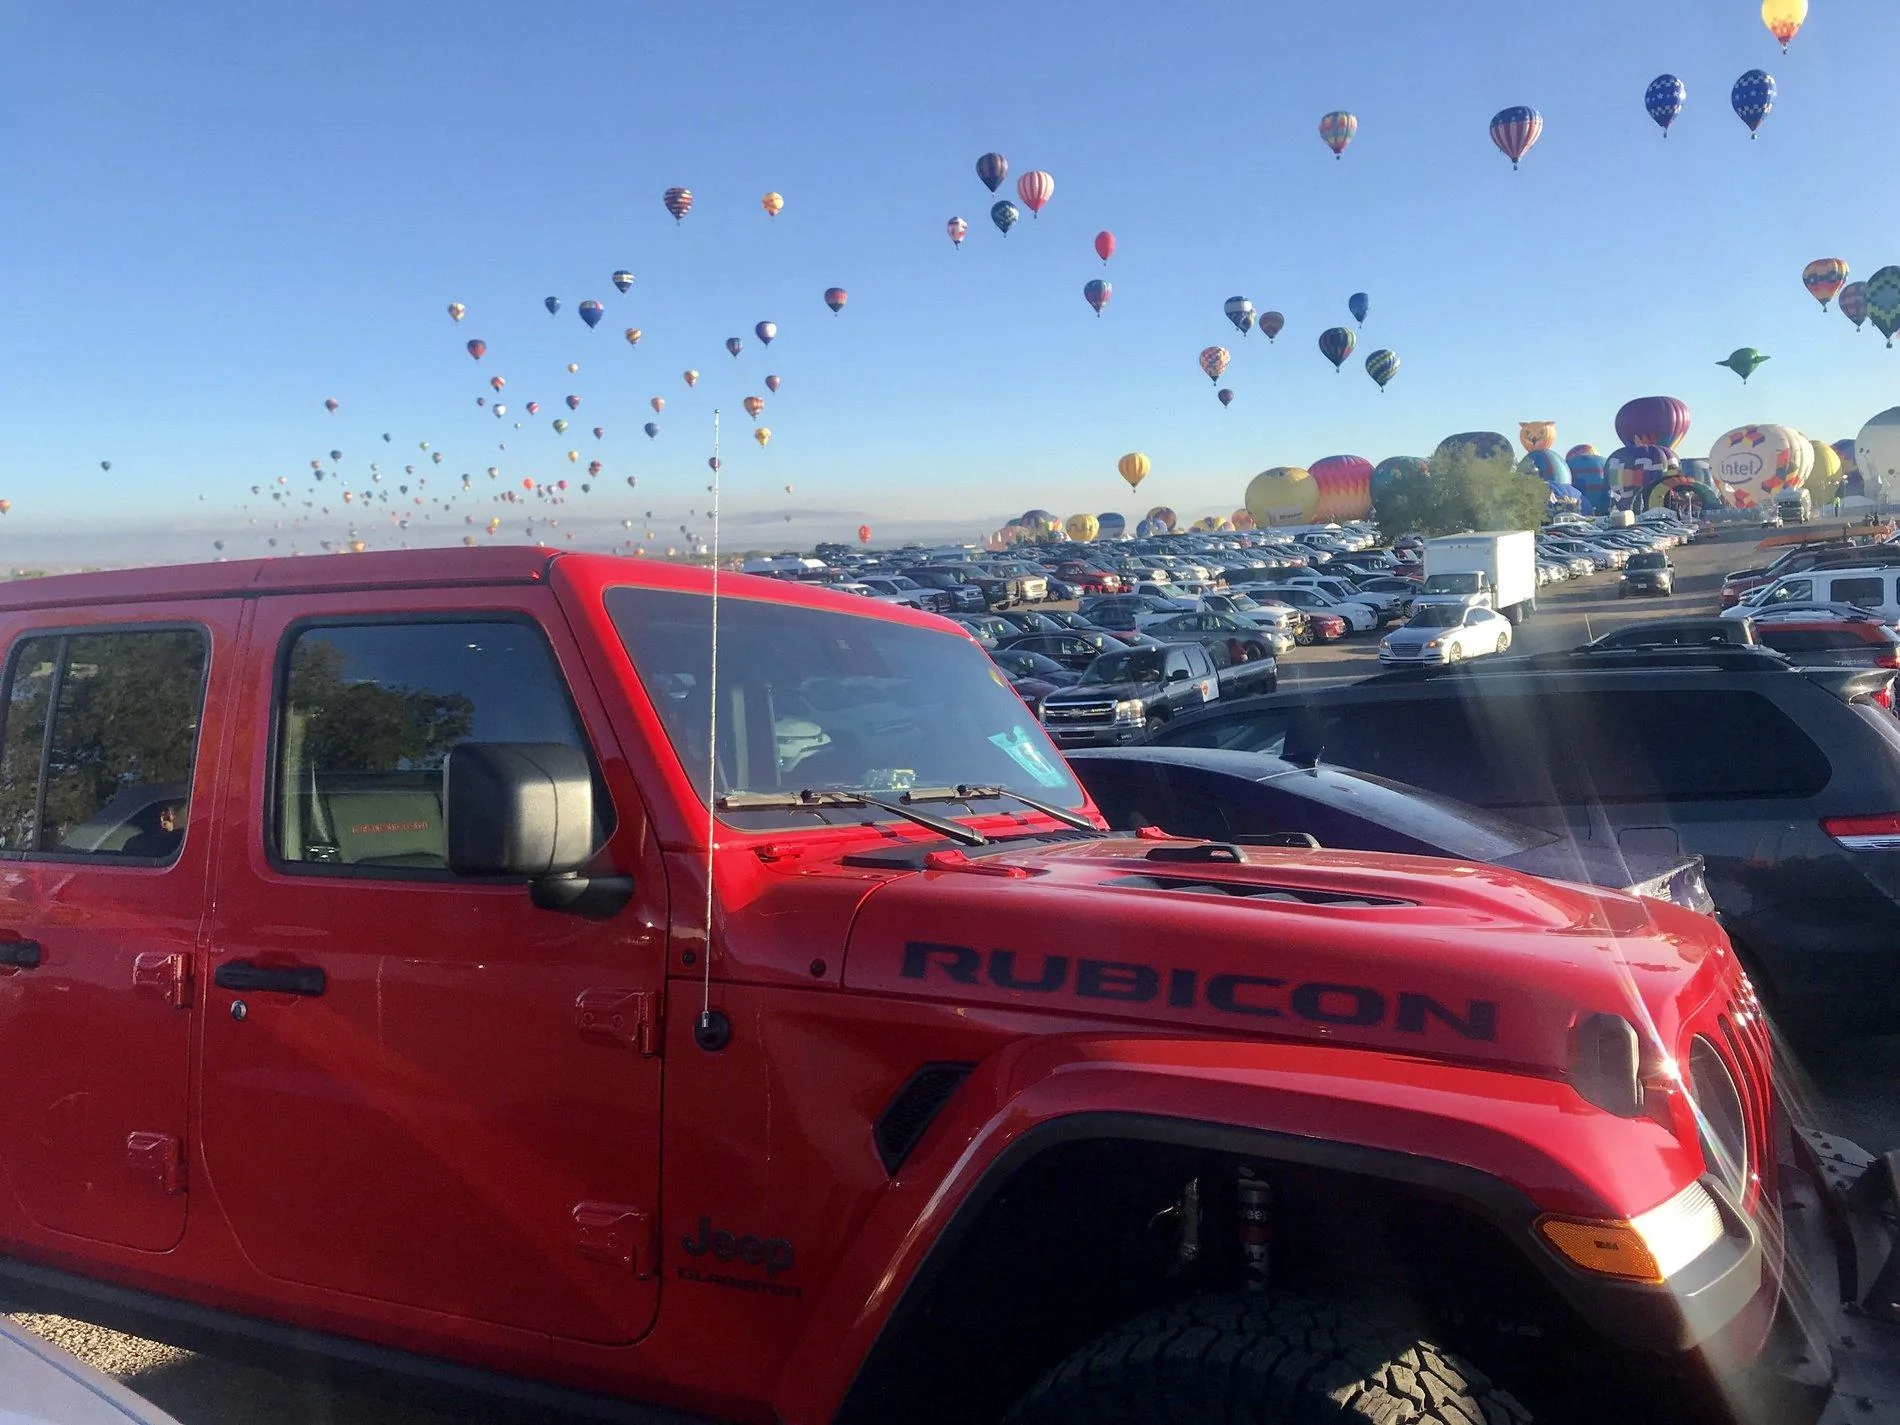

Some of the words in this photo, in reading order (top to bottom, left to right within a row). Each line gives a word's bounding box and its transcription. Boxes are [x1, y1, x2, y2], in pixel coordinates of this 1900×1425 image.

[1721, 460, 1754, 476] intel
[901, 940, 1499, 1042] RUBICON
[681, 1214, 795, 1277] Jeep
